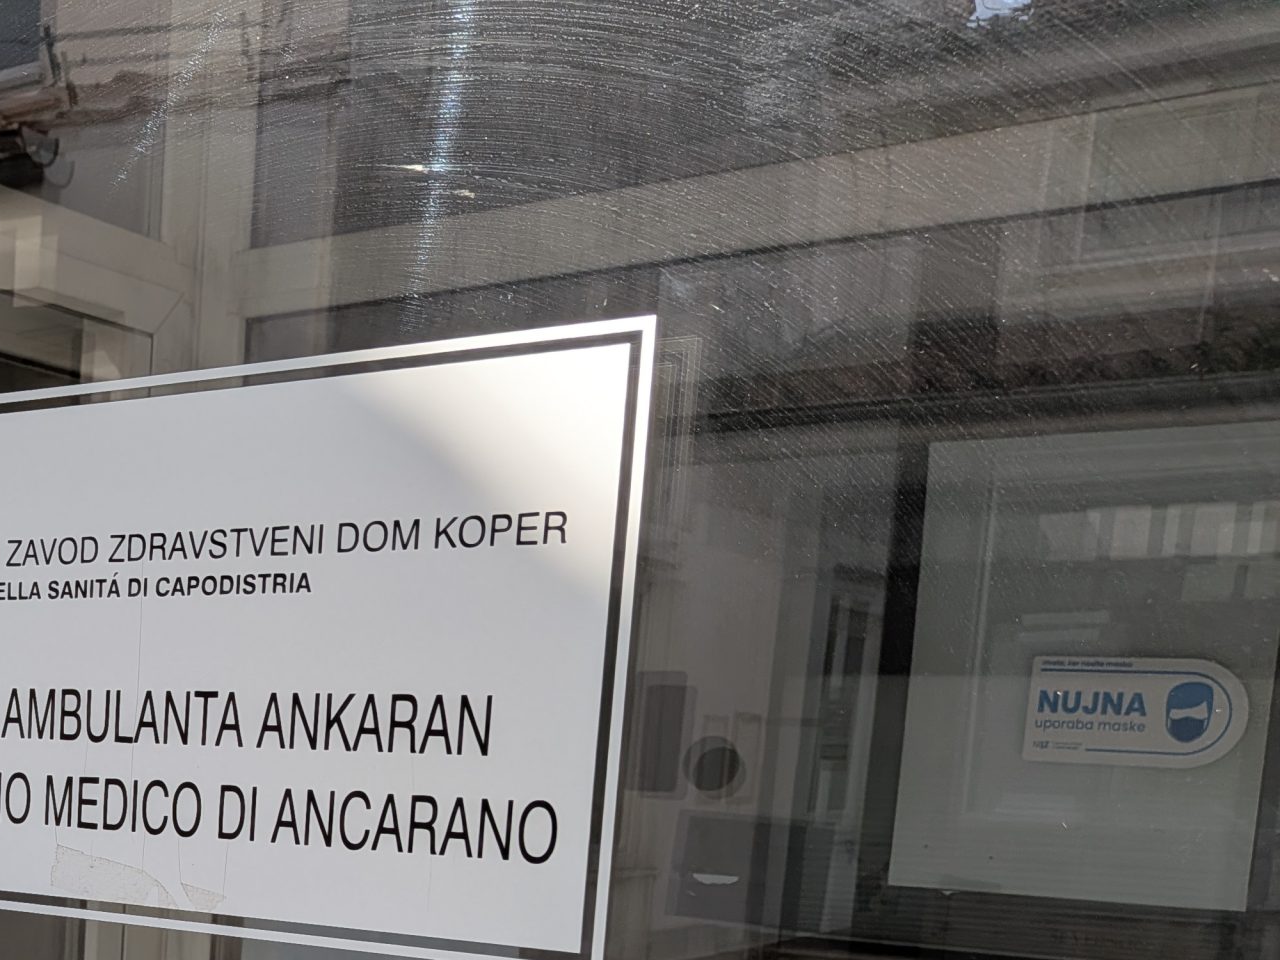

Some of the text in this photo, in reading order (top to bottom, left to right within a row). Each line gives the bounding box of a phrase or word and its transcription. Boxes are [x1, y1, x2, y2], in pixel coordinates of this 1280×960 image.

[5, 536, 99, 567] ZAVOD
[108, 525, 324, 562] ZDRAVSTVENI
[337, 519, 420, 553] DOM
[434, 511, 567, 548] KOPER
[127, 577, 148, 597] DI
[155, 572, 311, 596] CAPODISTRIA
[1, 688, 243, 746] AMBULANTA
[256, 693, 493, 755] ANKARAN
[1037, 689, 1147, 717] NUJNA
[1035, 717, 1146, 733] uporaba maske
[44, 776, 202, 837] MEDICO
[217, 784, 257, 841] DI
[270, 790, 558, 863] ANCARANO
